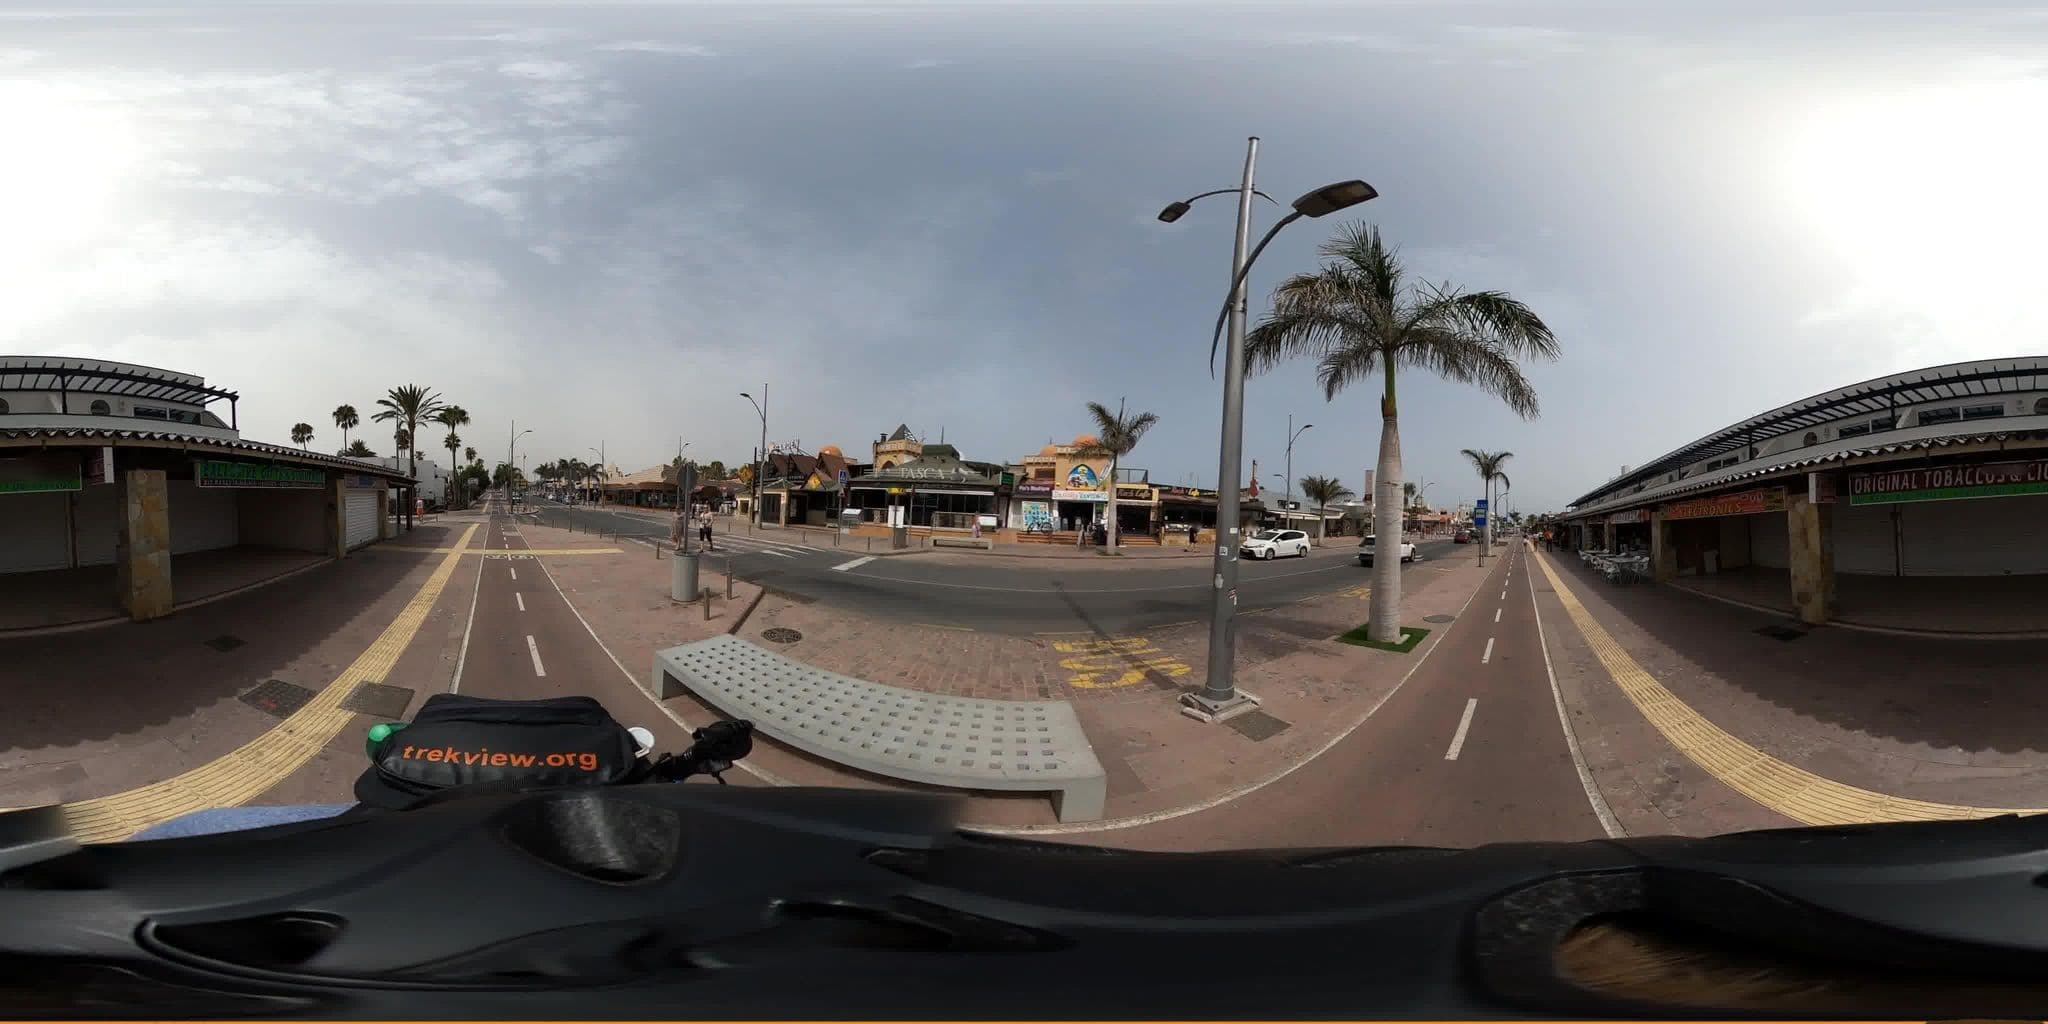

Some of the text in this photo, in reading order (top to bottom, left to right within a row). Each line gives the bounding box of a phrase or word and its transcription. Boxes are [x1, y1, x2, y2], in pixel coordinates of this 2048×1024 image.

[901, 467, 944, 479] TASCA
[1854, 473, 1918, 494] ORIGINAL
[402, 745, 598, 771] trekview.org
